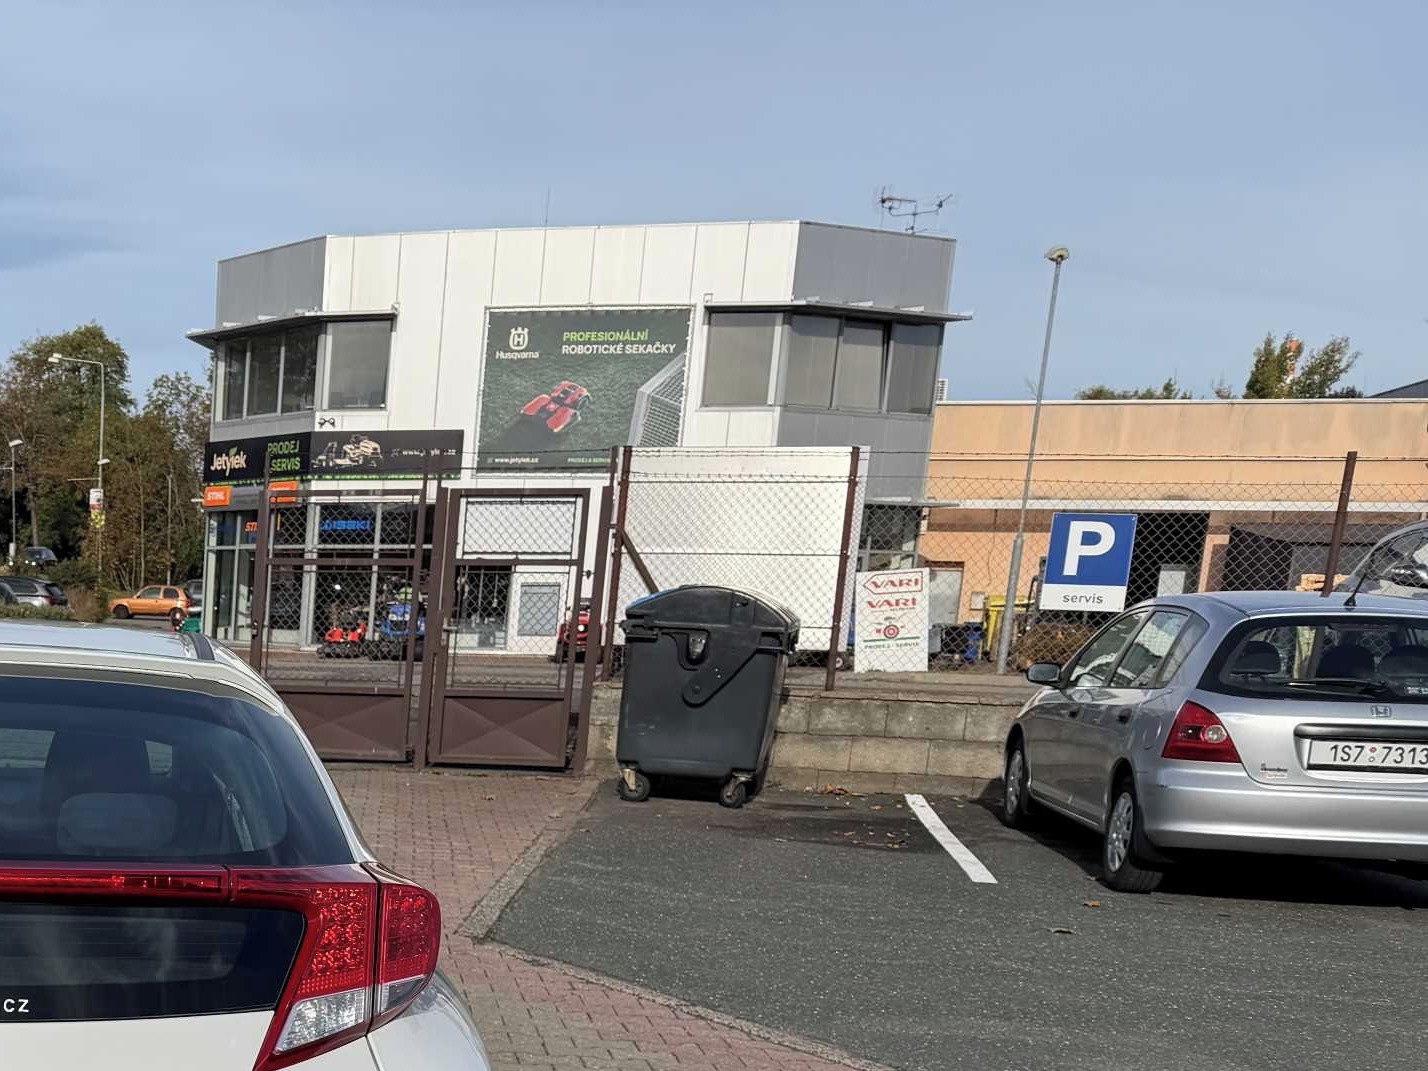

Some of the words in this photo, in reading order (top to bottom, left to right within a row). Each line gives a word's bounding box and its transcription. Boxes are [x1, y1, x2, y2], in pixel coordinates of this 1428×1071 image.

[563, 329, 649, 342] PROFESIONÁLNÍ
[562, 343, 623, 355] ROBOTICKÉ
[625, 341, 676, 354] SEKAČKY
[496, 350, 539, 360] Husqvarna
[267, 440, 300, 454] PRODEJ
[271, 457, 301, 472] SERVIS
[207, 491, 225, 501] STIHL
[332, 519, 371, 531] ISEKI
[1063, 520, 1116, 576] P
[871, 578, 920, 588] VARI
[867, 597, 917, 608] VARI
[1062, 593, 1104, 604] servis
[1330, 744, 1365, 763] 1S7
[1380, 746, 1428, 765] 7313
